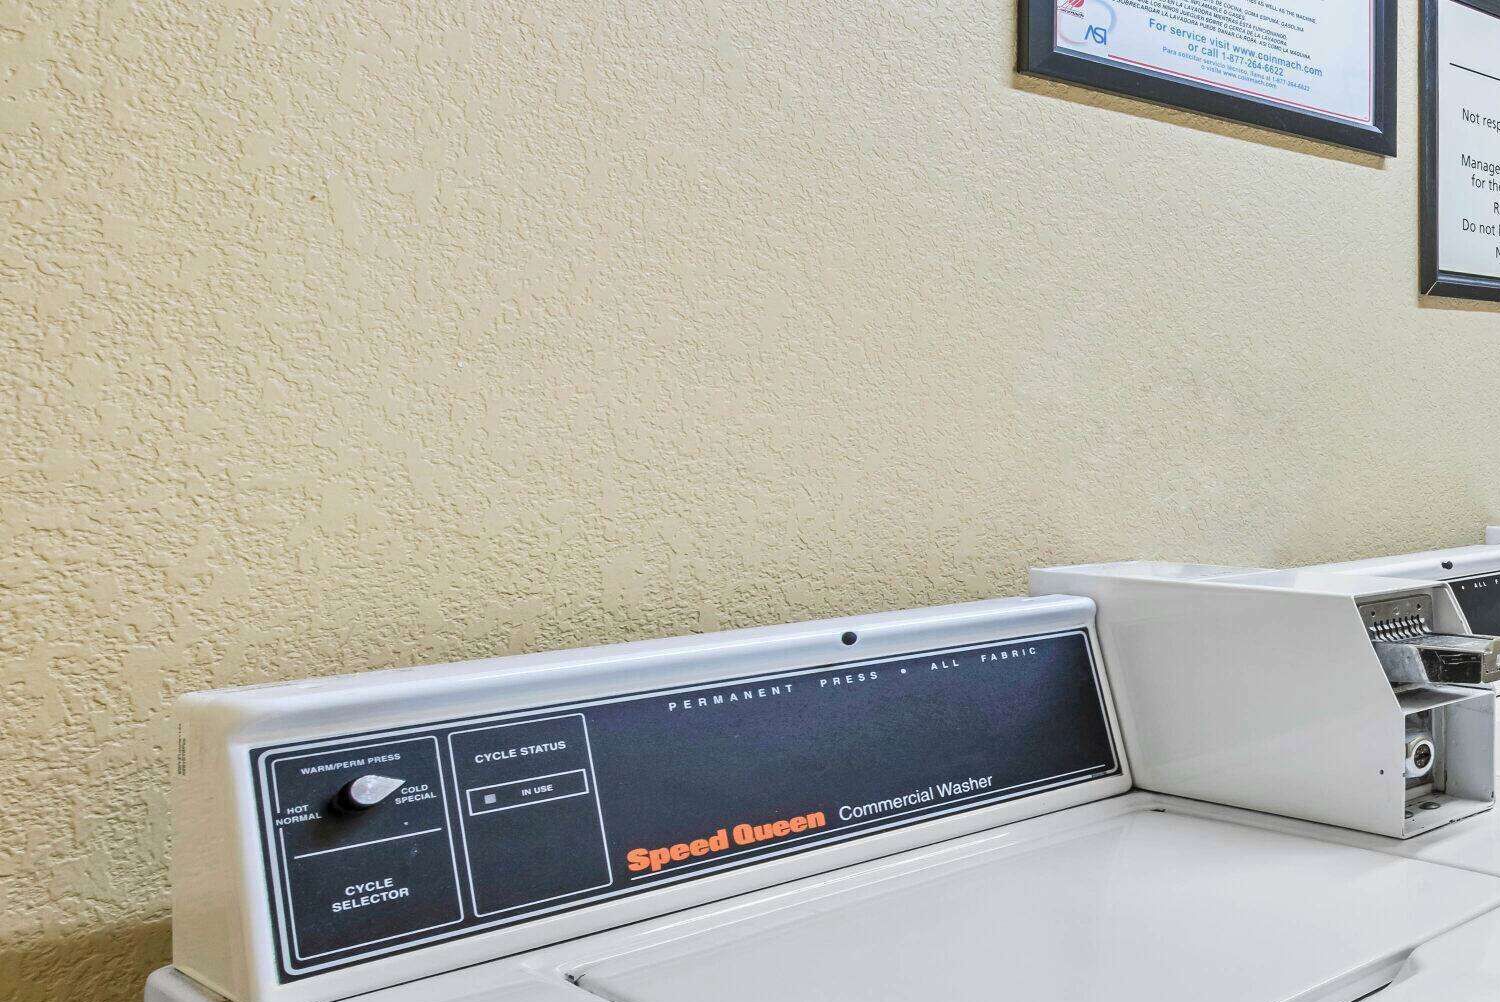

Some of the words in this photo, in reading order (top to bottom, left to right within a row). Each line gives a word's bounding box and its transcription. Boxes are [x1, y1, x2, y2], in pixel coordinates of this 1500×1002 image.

[1149, 18, 1168, 32] For
[1170, 26, 1207, 44] service
[1209, 37, 1230, 51] visit
[1232, 45, 1323, 77] www.coinmach.com
[1188, 43, 1199, 53] or
[1201, 47, 1219, 58] call
[1222, 52, 1284, 77] 1-877-264-6622
[1462, 107, 1480, 125] Not
[1471, 173, 1485, 188] for
[1462, 218, 1476, 233] Do
[1479, 223, 1495, 236] not
[1473, 580, 1488, 589] ALL
[669, 684, 793, 712] PERMANENT
[820, 671, 879, 688] PRESS
[930, 659, 960, 671] ALL
[980, 647, 1036, 663] FABRIC
[474, 748, 518, 764] CYCLE
[520, 740, 567, 756] STATUS
[300, 759, 365, 775] WARM/PERM
[367, 753, 401, 764] PRESS
[394, 791, 437, 805] SPECIAL
[400, 784, 429, 795] COLD
[521, 788, 532, 797] IN
[533, 784, 554, 794] USE
[838, 786, 934, 822] Commercial
[936, 775, 993, 798] Washer
[286, 804, 309, 815] HOT
[275, 812, 323, 826] NORMAL
[626, 829, 730, 872] Speed
[732, 810, 827, 847] Queen
[344, 877, 394, 896] CYCLE
[331, 887, 410, 913] SELECTOR
